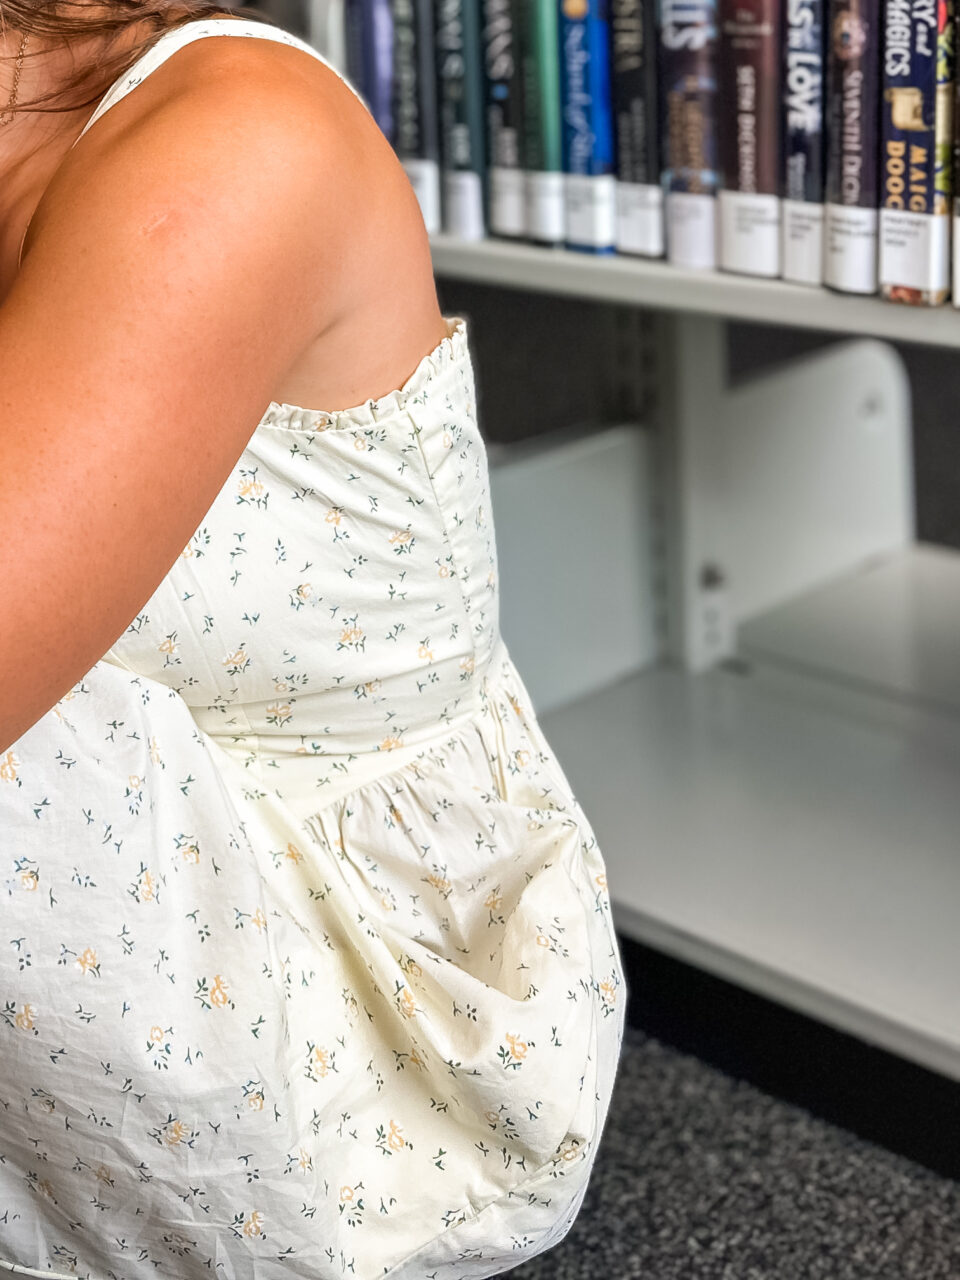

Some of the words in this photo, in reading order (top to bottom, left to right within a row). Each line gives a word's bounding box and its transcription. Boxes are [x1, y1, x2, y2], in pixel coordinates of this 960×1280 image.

[915, 22, 932, 57] and
[785, 50, 823, 136] LOVE
[885, 140, 906, 210] DOOC
[909, 143, 928, 212] MAIG
